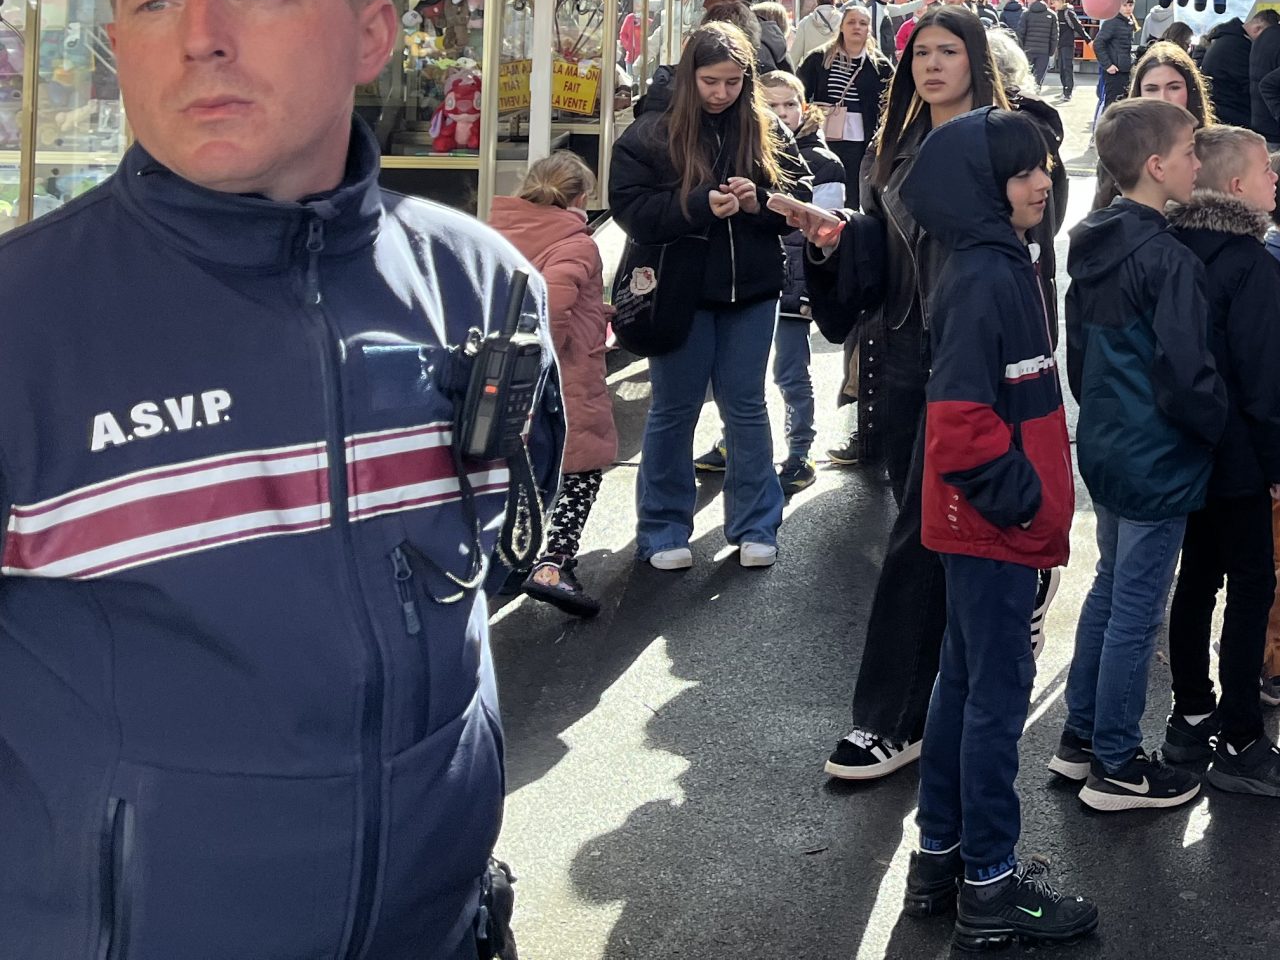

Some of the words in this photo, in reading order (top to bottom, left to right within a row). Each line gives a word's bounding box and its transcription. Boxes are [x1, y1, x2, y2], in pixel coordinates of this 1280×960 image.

[565, 66, 600, 81] MAON
[563, 80, 582, 93] FAIT
[563, 98, 588, 110] VENTE
[91, 390, 232, 452] A.S.V.P.
